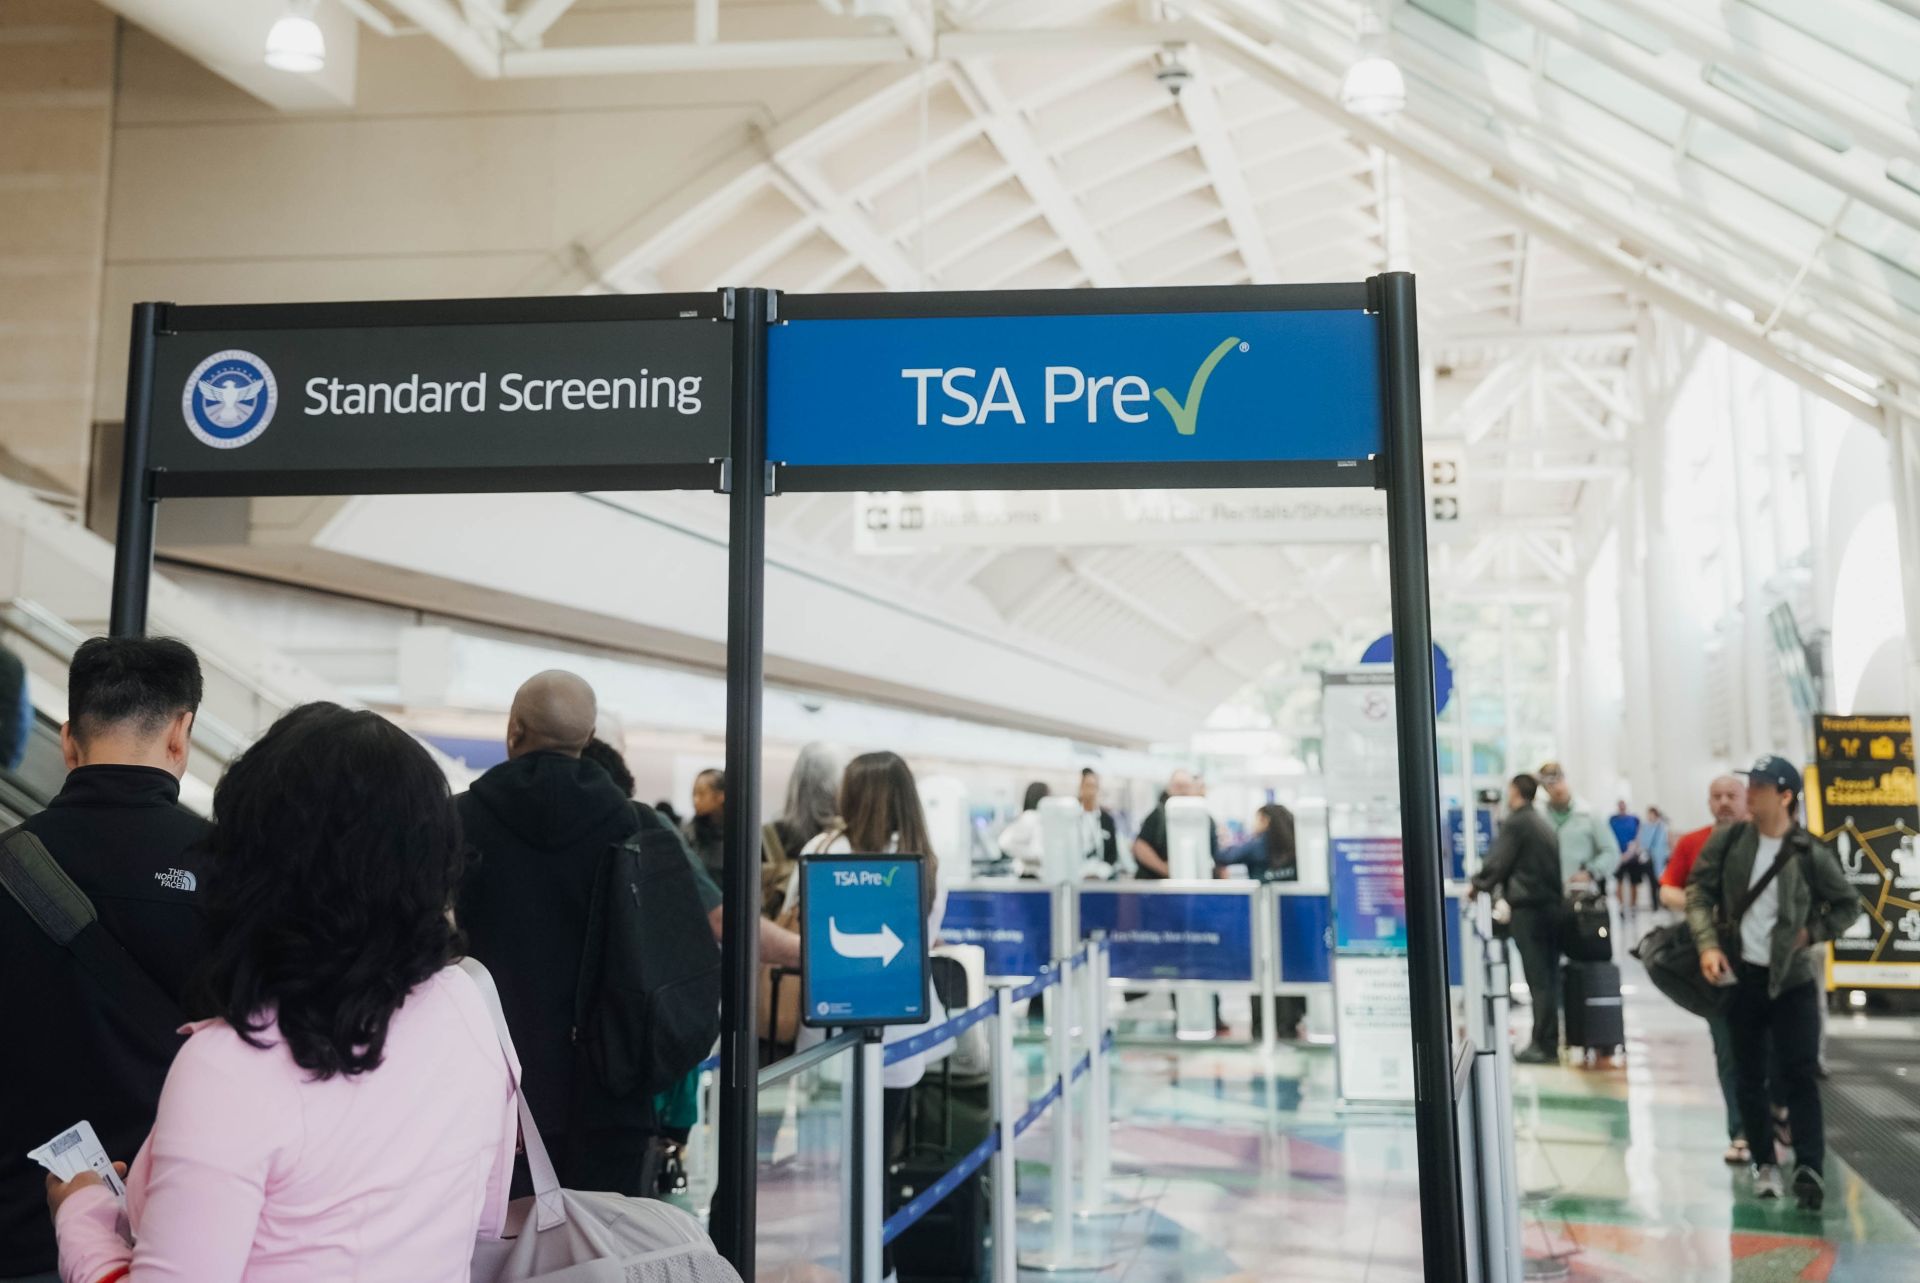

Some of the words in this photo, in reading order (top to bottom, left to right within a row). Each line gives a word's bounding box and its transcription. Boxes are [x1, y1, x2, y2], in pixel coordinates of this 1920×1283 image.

[304, 373, 488, 416] Standard
[499, 369, 702, 415] Screening
[901, 367, 1026, 427] TSA
[154, 872, 183, 883] NORTH
[168, 867, 185, 877] THE
[833, 871, 858, 886] TSA
[161, 880, 182, 889] FACE
